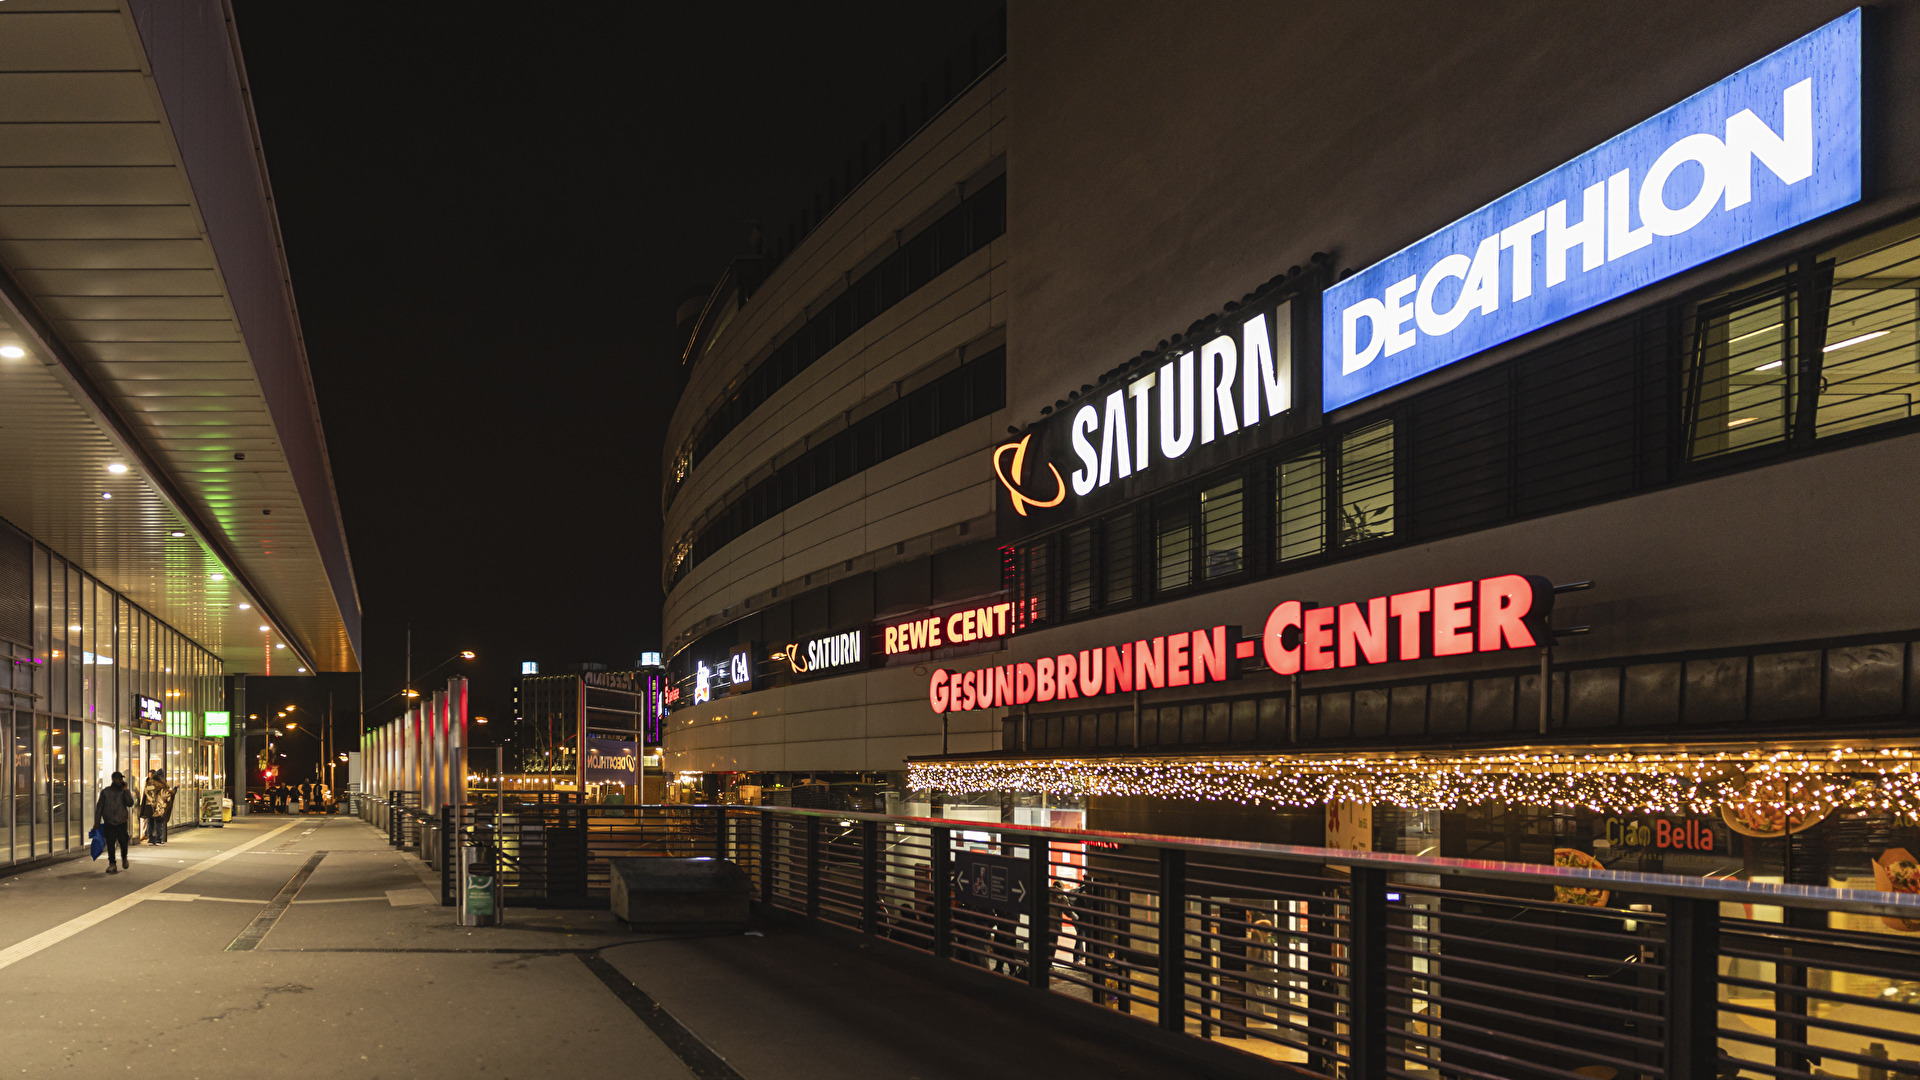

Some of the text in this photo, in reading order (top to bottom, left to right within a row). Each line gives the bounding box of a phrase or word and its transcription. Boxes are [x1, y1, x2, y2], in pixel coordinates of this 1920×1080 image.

[1342, 77, 1813, 376] DECATHLON
[1072, 300, 1291, 496] SATURN
[808, 630, 861, 671] SATURN
[885, 616, 941, 655] REWE
[930, 624, 1227, 714] GESUNDBRUNNEN
[1263, 573, 1536, 675] CENTER
[1606, 817, 1714, 851] Ciao Bella
